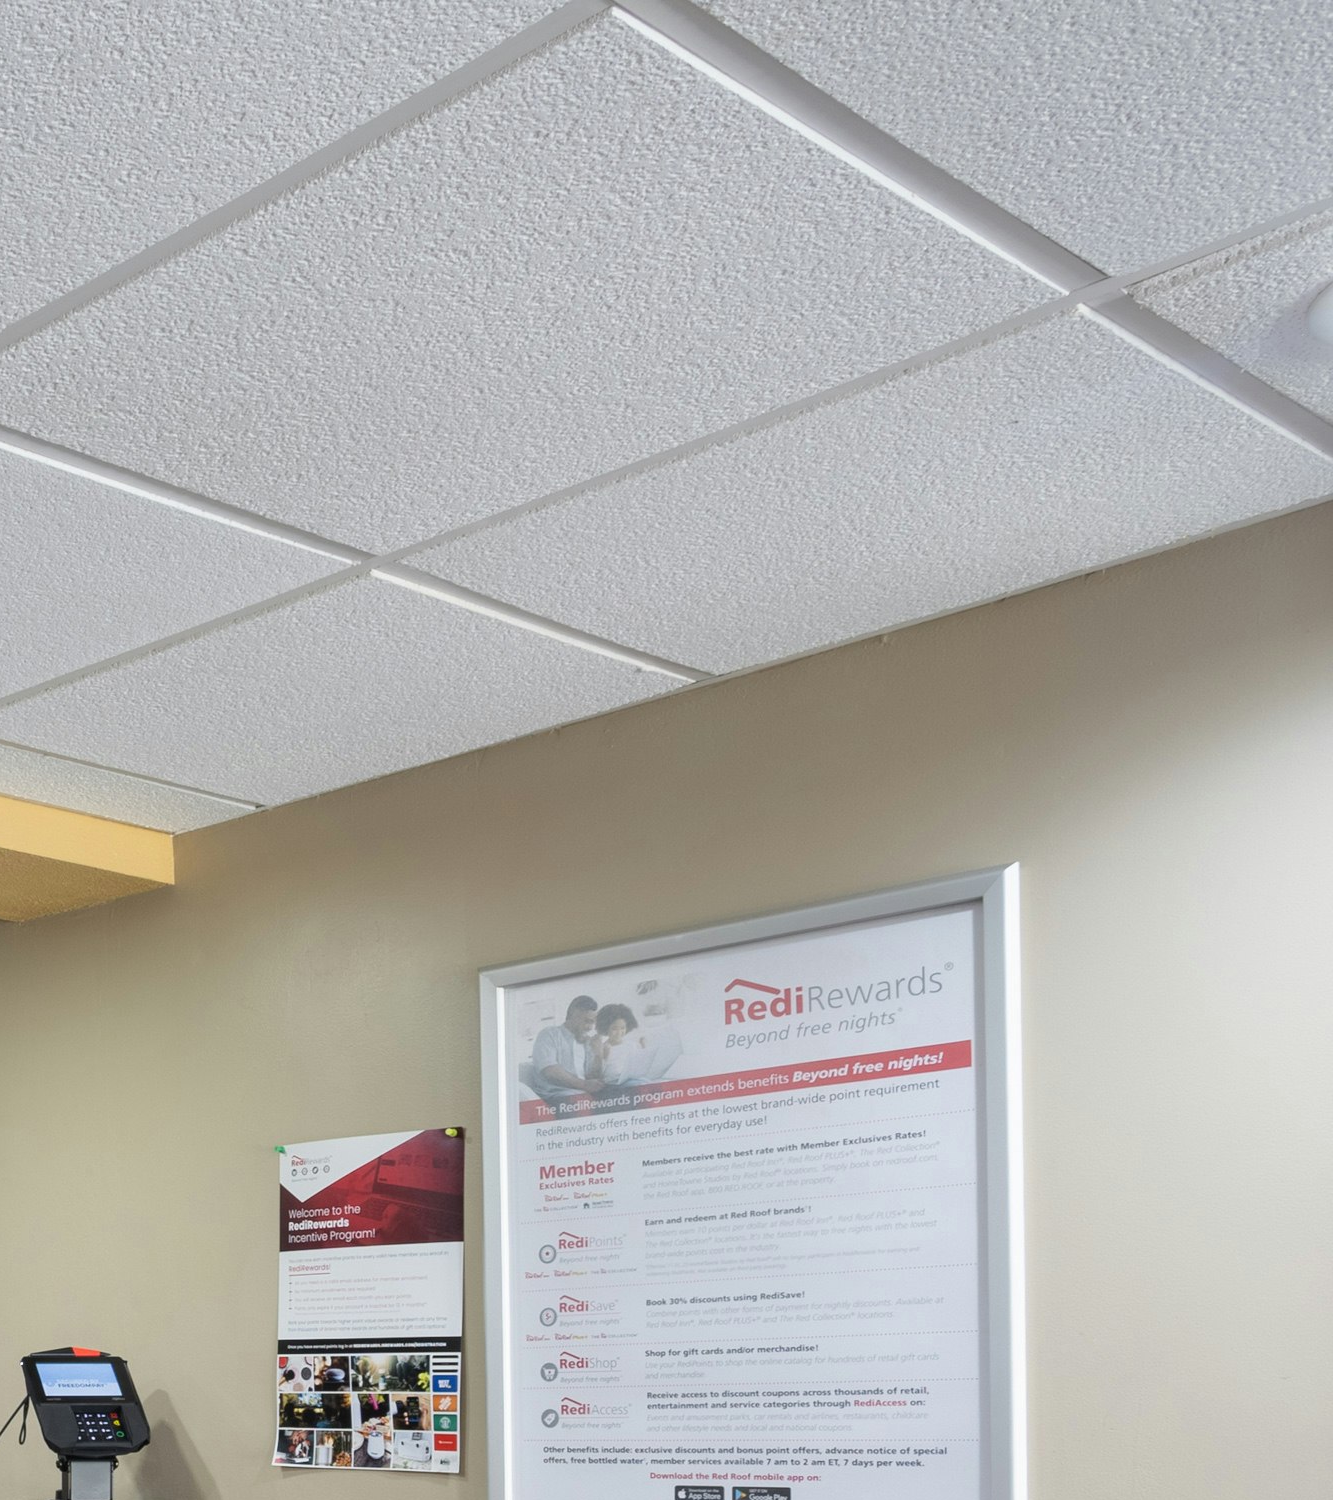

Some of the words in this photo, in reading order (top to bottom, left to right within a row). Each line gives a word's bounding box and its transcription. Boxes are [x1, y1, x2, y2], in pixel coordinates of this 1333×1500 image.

[725, 1023, 790, 1049] Beyond
[796, 1021, 832, 1038] free
[535, 1105, 556, 1115] The
[559, 1094, 630, 1112] RediRewards
[633, 1089, 683, 1105] program
[686, 1079, 734, 1096] extends
[737, 1073, 789, 1089] benefits
[792, 1063, 849, 1083] Beyond
[851, 1061, 883, 1074] free
[887, 1051, 943, 1070] nights!
[535, 1121, 597, 1137] RediRewards
[599, 1118, 628, 1129] offers
[630, 1115, 651, 1125] free
[653, 1111, 685, 1124] nights
[687, 1109, 698, 1118] at
[701, 1106, 719, 1116] the
[722, 1101, 758, 1114] lowest
[760, 1092, 826, 1109] brand-wide
[828, 1087, 860, 1104] point
[863, 1079, 940, 1097] requirement
[535, 1142, 545, 1151] in
[547, 1139, 563, 1150] the
[565, 1136, 604, 1147] industry
[606, 1131, 629, 1142] with
[631, 1126, 673, 1139] benefits
[676, 1124, 691, 1134] for
[694, 1118, 742, 1133] everyday
[744, 1114, 767, 1127] use!
[641, 1157, 681, 1166] Members
[683, 1153, 714, 1162] receive
[716, 1151, 731, 1159] the
[733, 1148, 753, 1157] best
[776, 1143, 797, 1152] with
[800, 1139, 840, 1149] Member
[842, 1134, 892, 1145] Exclusives
[894, 1129, 925, 1139] Rates!
[539, 1160, 614, 1179] Member
[539, 1179, 585, 1190] Exclusives
[588, 1176, 614, 1185] Rates
[289, 1206, 330, 1219] Welcome
[332, 1206, 342, 1216] to
[344, 1204, 361, 1214] the
[644, 1218, 664, 1226] Earn
[665, 1215, 682, 1224] and
[684, 1214, 716, 1222] redeem
[730, 1210, 747, 1218] Red
[749, 1208, 770, 1217] Roof
[288, 1217, 350, 1231] RediRewards
[288, 1232, 328, 1243] Incentive
[330, 1228, 376, 1242] Program!
[645, 1298, 666, 1306] Book
[669, 1297, 687, 1305] 30%
[689, 1295, 730, 1303] discounts
[732, 1293, 757, 1302] using
[759, 1290, 804, 1300] RediSave!
[644, 1349, 666, 1358] Shop
[667, 1348, 681, 1356] for
[682, 1347, 698, 1357] gift
[700, 1346, 723, 1355] cards
[725, 1346, 754, 1354] and/or
[756, 1344, 818, 1353] merchandise!
[646, 1391, 678, 1399] Receive
[721, 1389, 759, 1397] discount
[761, 1390, 800, 1398] coupons
[833, 1387, 884, 1395] thousands
[886, 1386, 897, 1394] of
[900, 1386, 929, 1394] retail,
[710, 1400, 727, 1408] and
[729, 1400, 760, 1408] service
[762, 1400, 810, 1409] categories
[812, 1399, 851, 1409] through
[853, 1398, 906, 1406] RediAccess
[566, 1445, 599, 1453] benefits
[736, 1446, 763, 1454] bonus
[765, 1446, 789, 1455] point
[791, 1446, 822, 1455] offers,
[824, 1446, 864, 1454] advance
[866, 1446, 897, 1454] notice
[899, 1446, 910, 1454] of
[912, 1446, 947, 1456] special
[543, 1456, 568, 1464] offers,
[570, 1456, 586, 1464] free
[587, 1456, 617, 1464] bottled
[687, 1457, 721, 1465] services
[723, 1457, 764, 1465] available
[827, 1458, 840, 1466] ET,
[843, 1458, 848, 1466] 7
[851, 1458, 874, 1468] days
[876, 1460, 893, 1468] per
[895, 1458, 924, 1466] week.
[730, 1472, 751, 1480] Roof
[786, 1474, 804, 1482] app
[688, 1492, 702, 1500] App
[703, 1492, 721, 1500] Store
